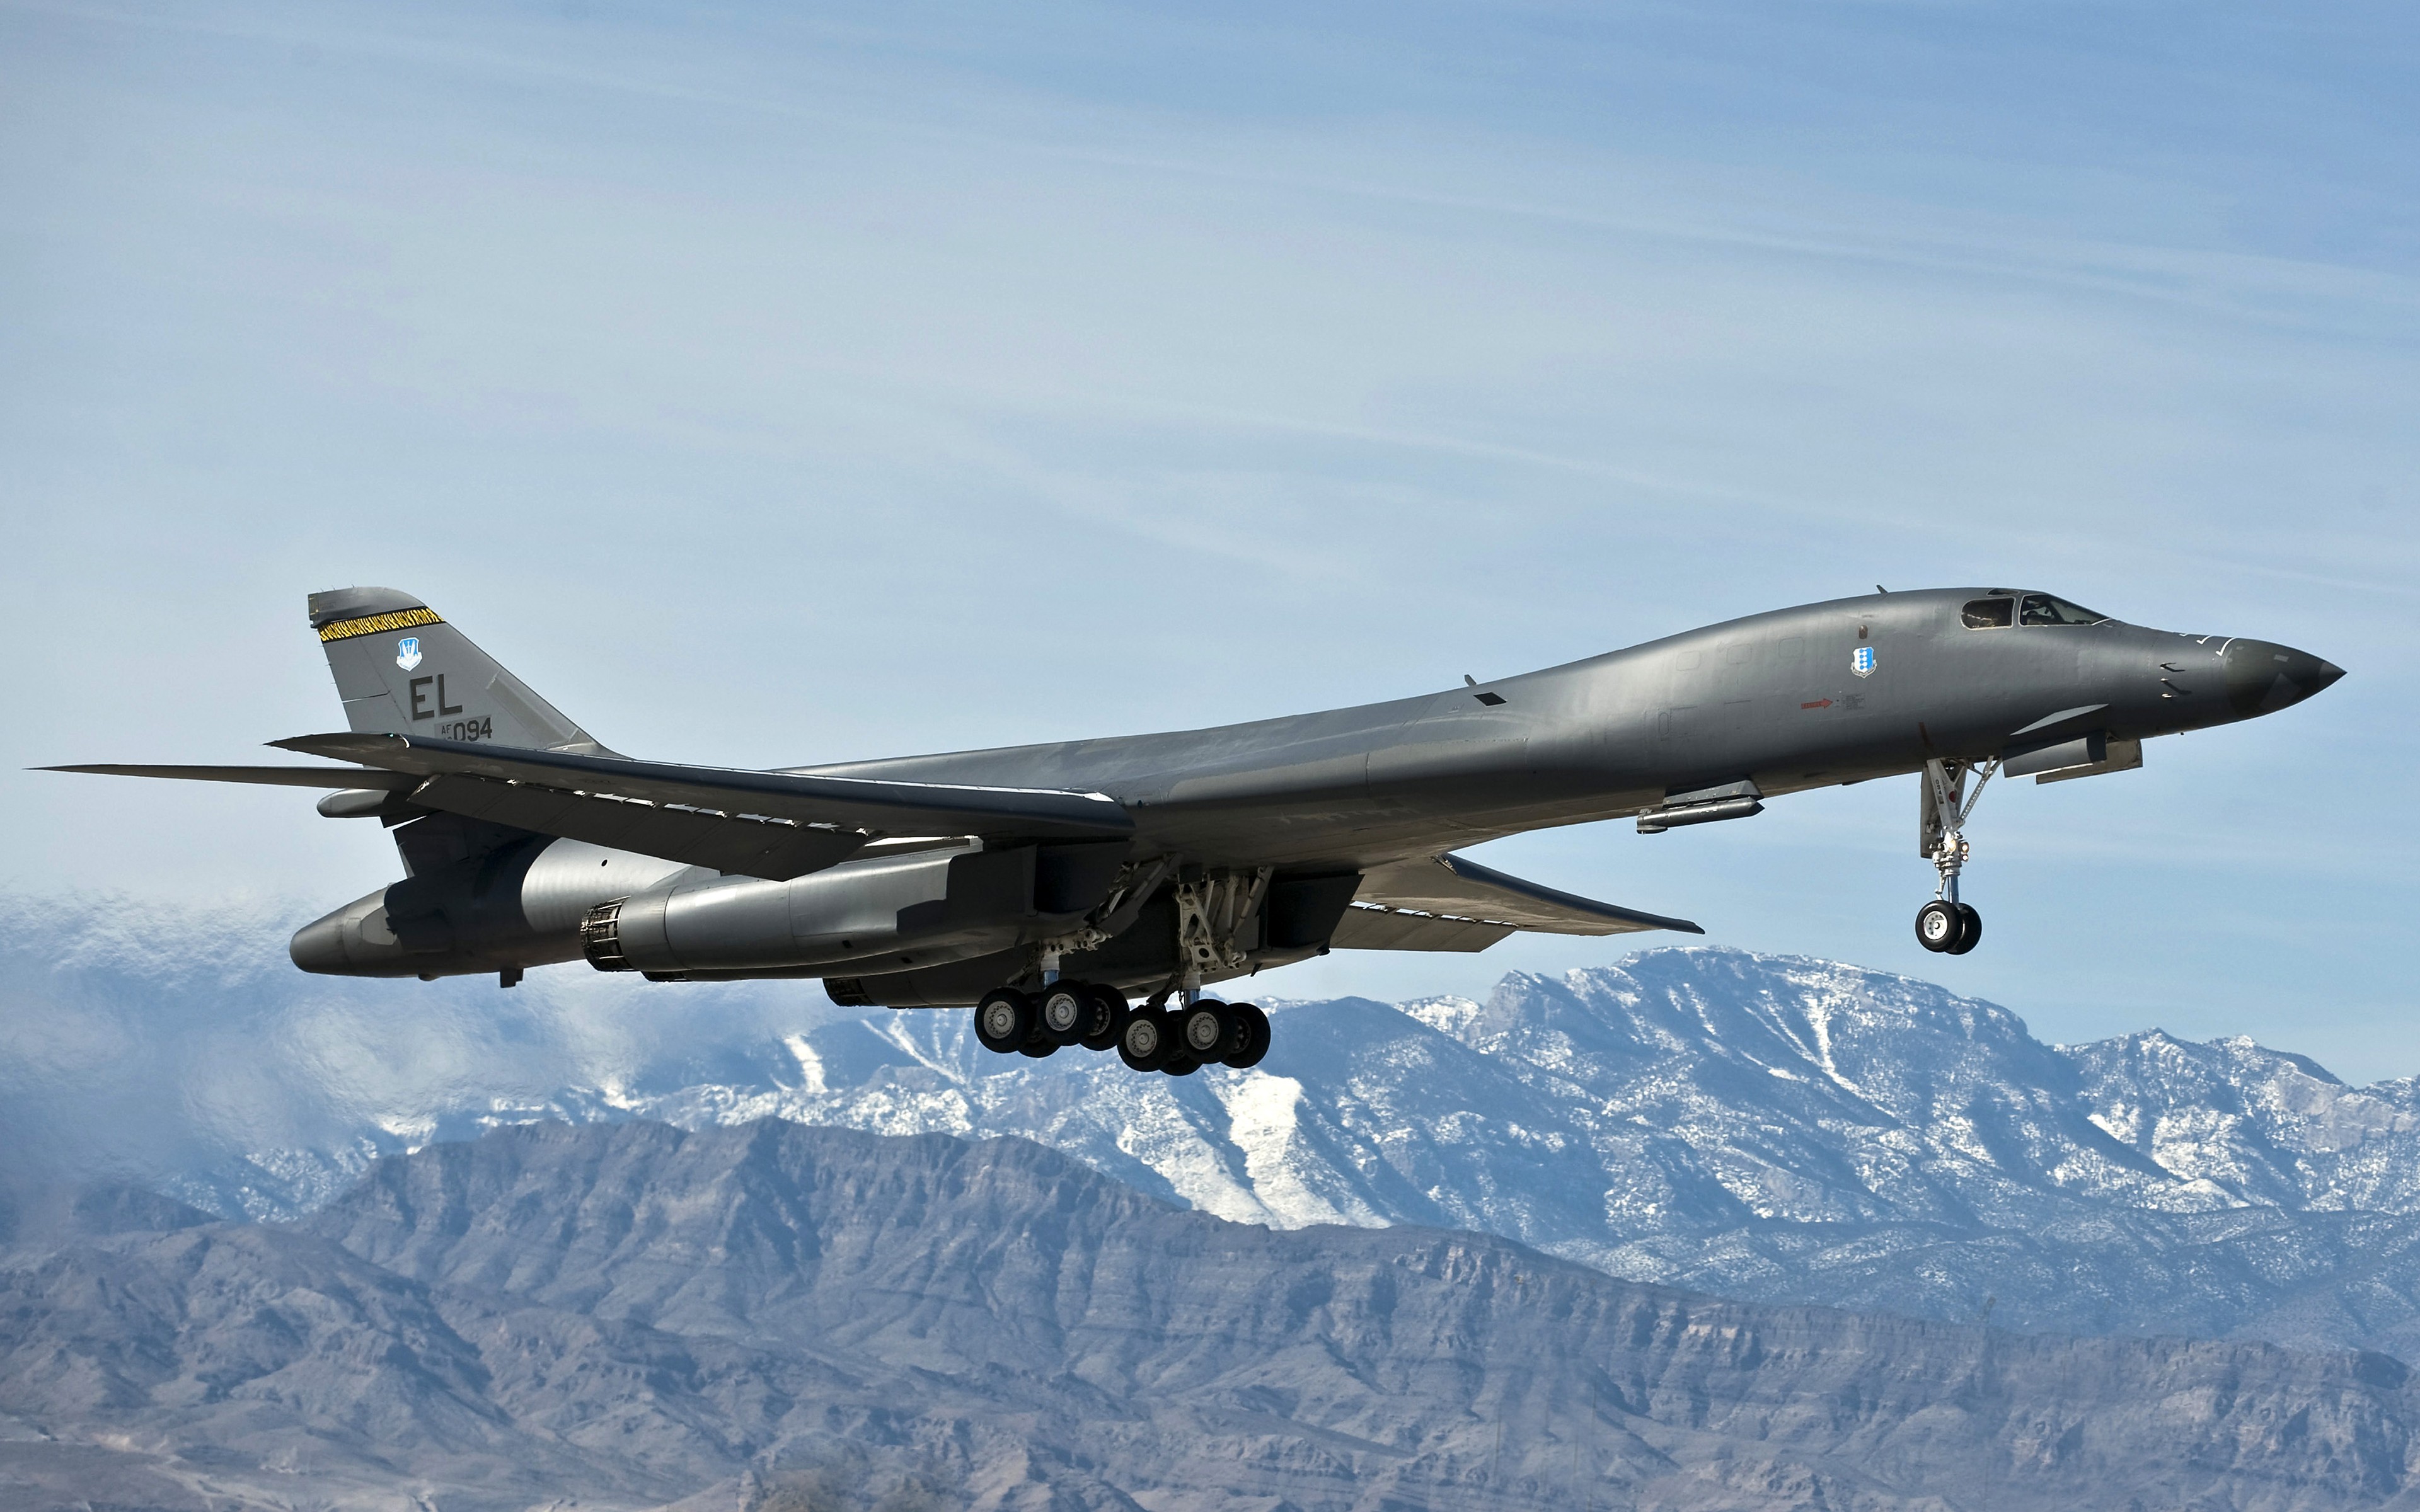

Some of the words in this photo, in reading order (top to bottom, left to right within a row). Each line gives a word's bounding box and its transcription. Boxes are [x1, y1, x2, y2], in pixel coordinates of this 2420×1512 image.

[410, 673, 463, 720] EL
[442, 724, 452, 735] AF
[454, 717, 492, 742] 094
